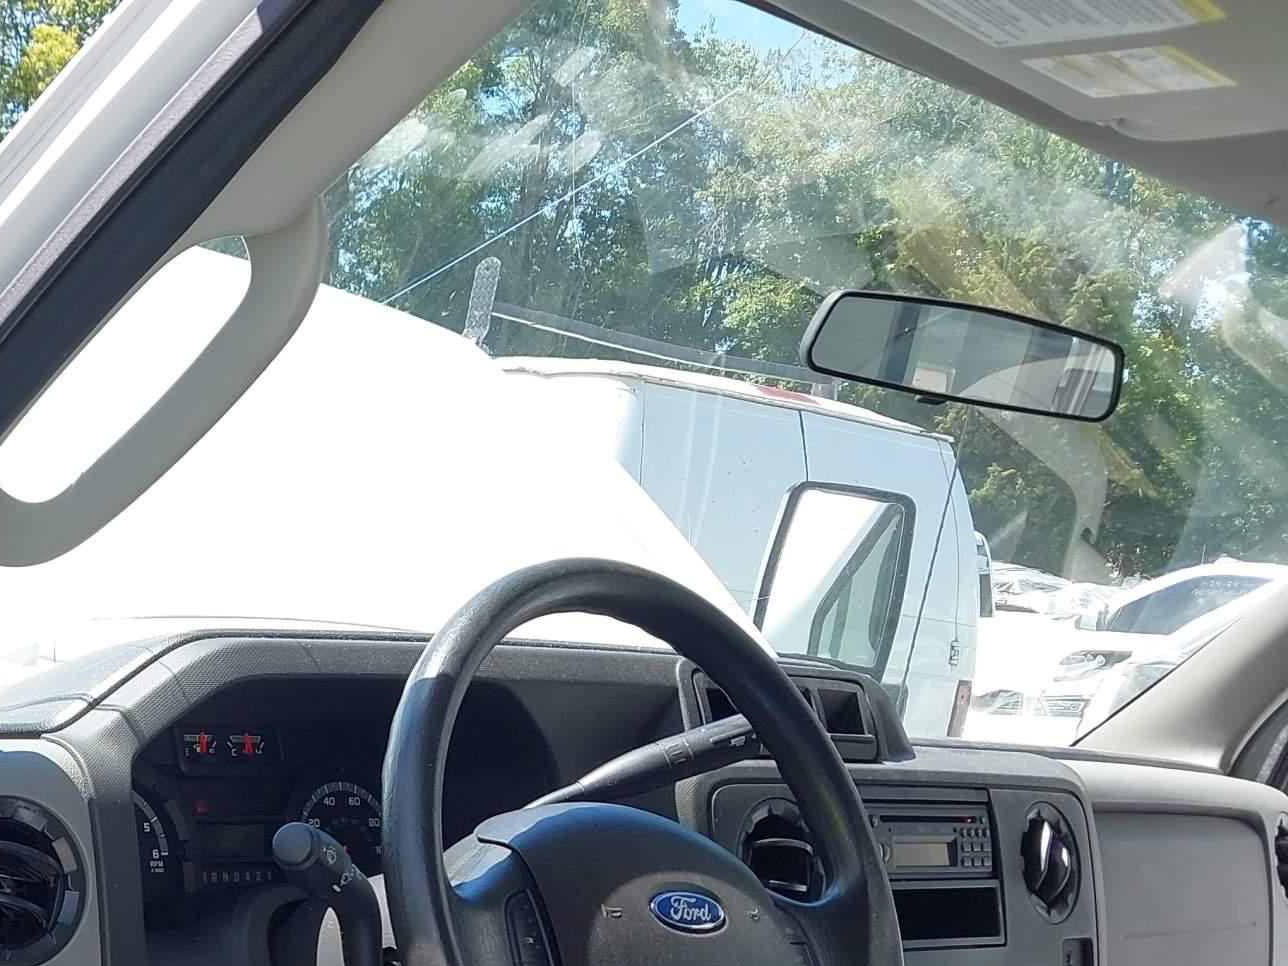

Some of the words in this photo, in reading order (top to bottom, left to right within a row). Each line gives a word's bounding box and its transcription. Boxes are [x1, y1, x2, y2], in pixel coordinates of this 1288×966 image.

[323, 796, 336, 806] 40
[348, 796, 361, 806] 60
[143, 822, 151, 832] 5
[152, 849, 160, 859] 6
[670, 895, 712, 921] Ford
